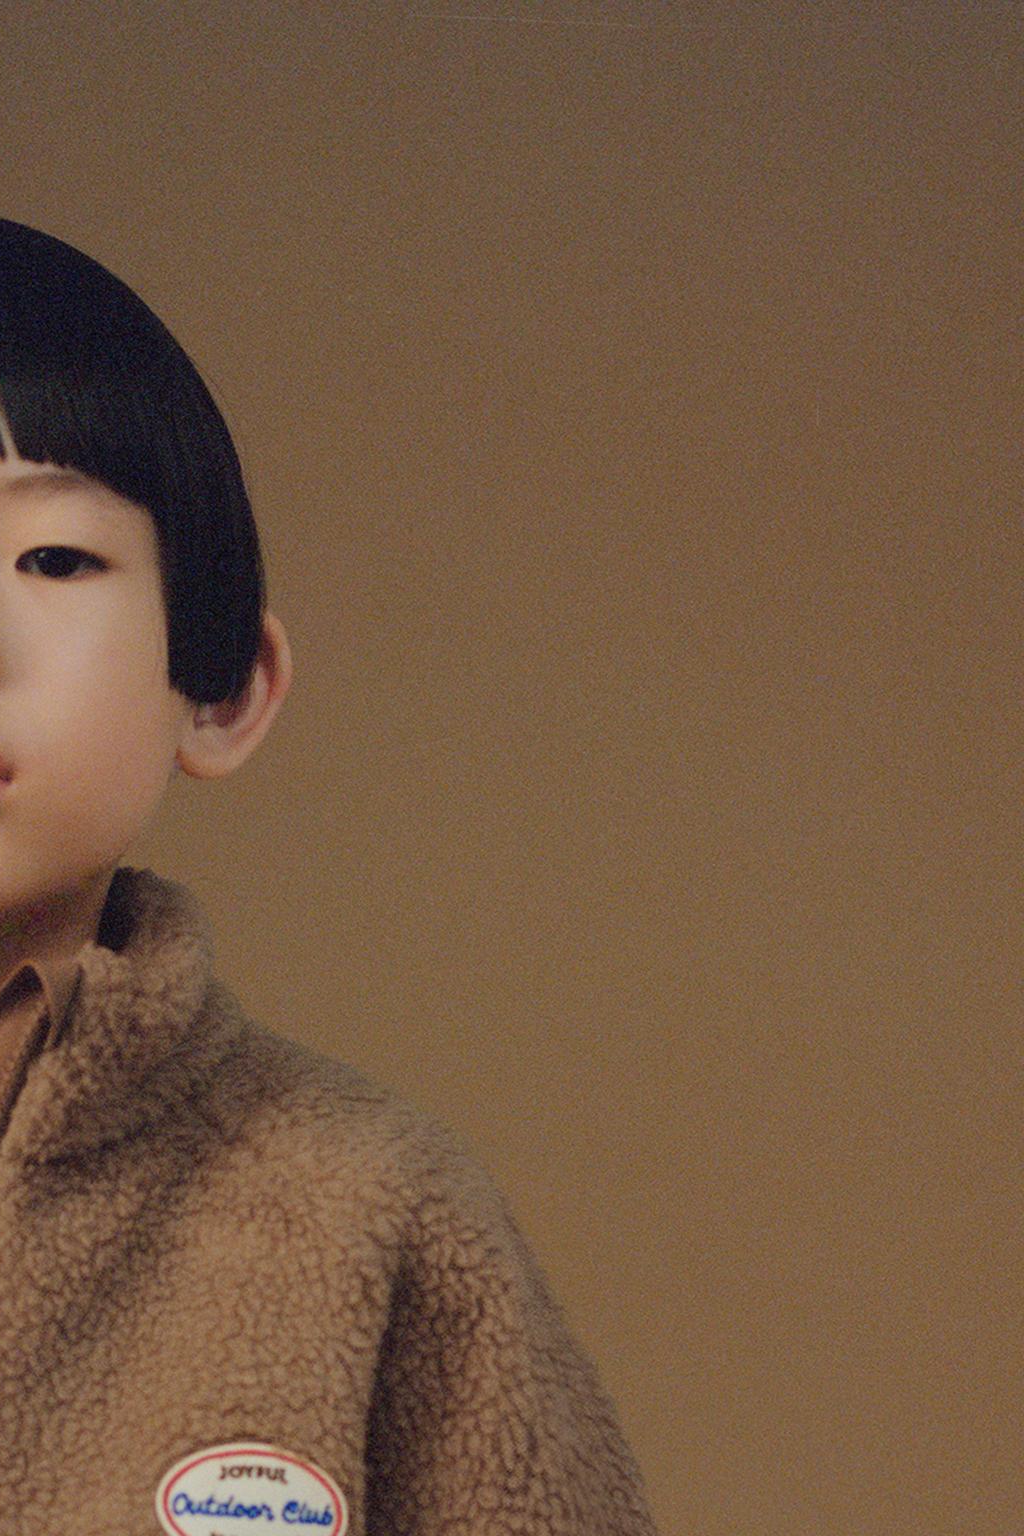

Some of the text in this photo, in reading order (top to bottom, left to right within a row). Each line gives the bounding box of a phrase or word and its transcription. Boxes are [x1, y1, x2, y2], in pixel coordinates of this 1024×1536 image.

[219, 1465, 288, 1485] JOYFUL
[172, 1492, 334, 1526] Outdoor Club
